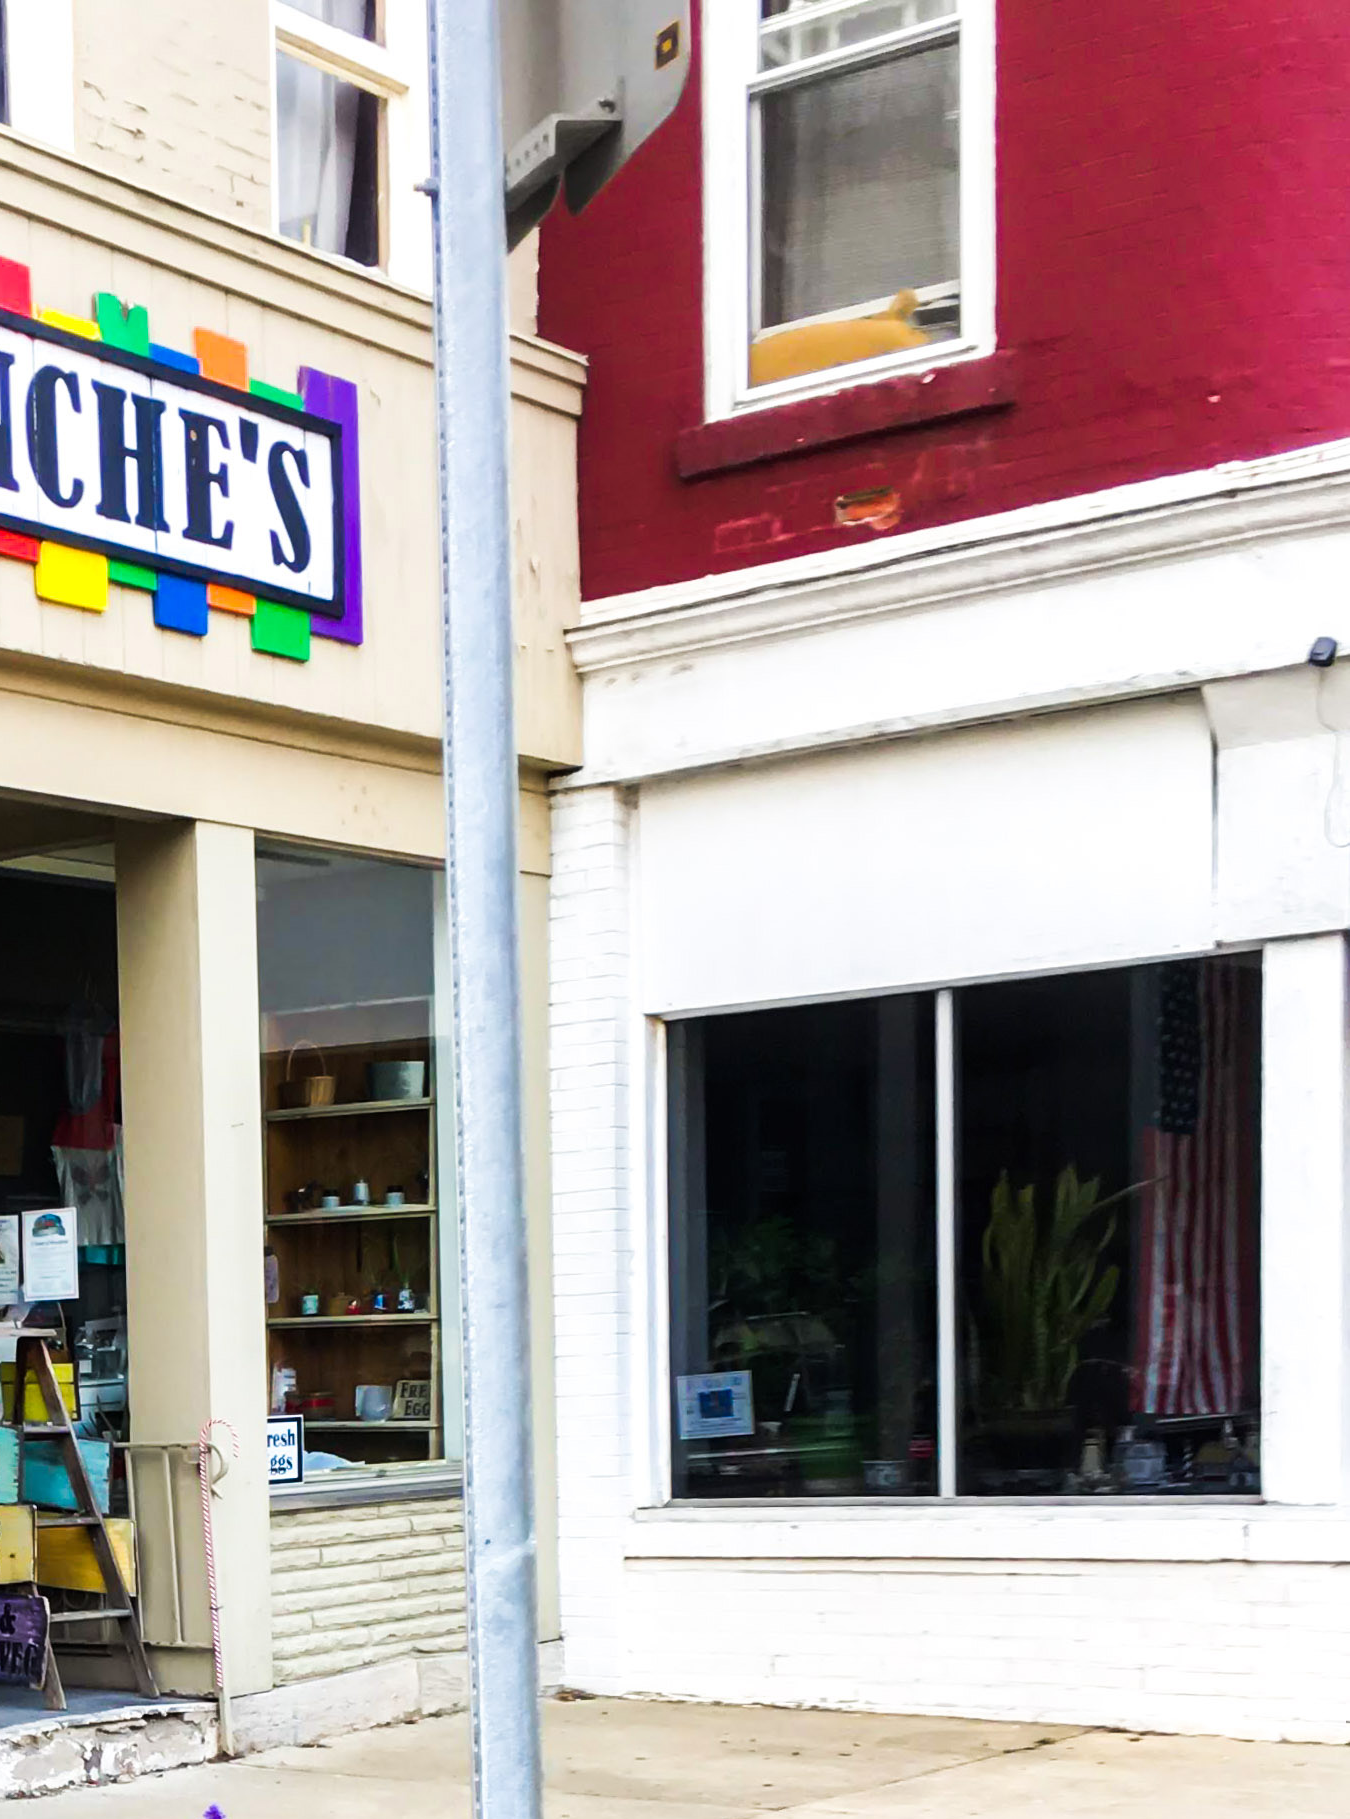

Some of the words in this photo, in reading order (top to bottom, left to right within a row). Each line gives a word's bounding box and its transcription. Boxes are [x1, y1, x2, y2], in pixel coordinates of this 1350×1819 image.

[400, 1381, 427, 1398] FRE
[405, 1401, 430, 1417] EGG
[267, 1429, 296, 1448] resh
[268, 1454, 293, 1476] ggs
[0, 1602, 17, 1635] &
